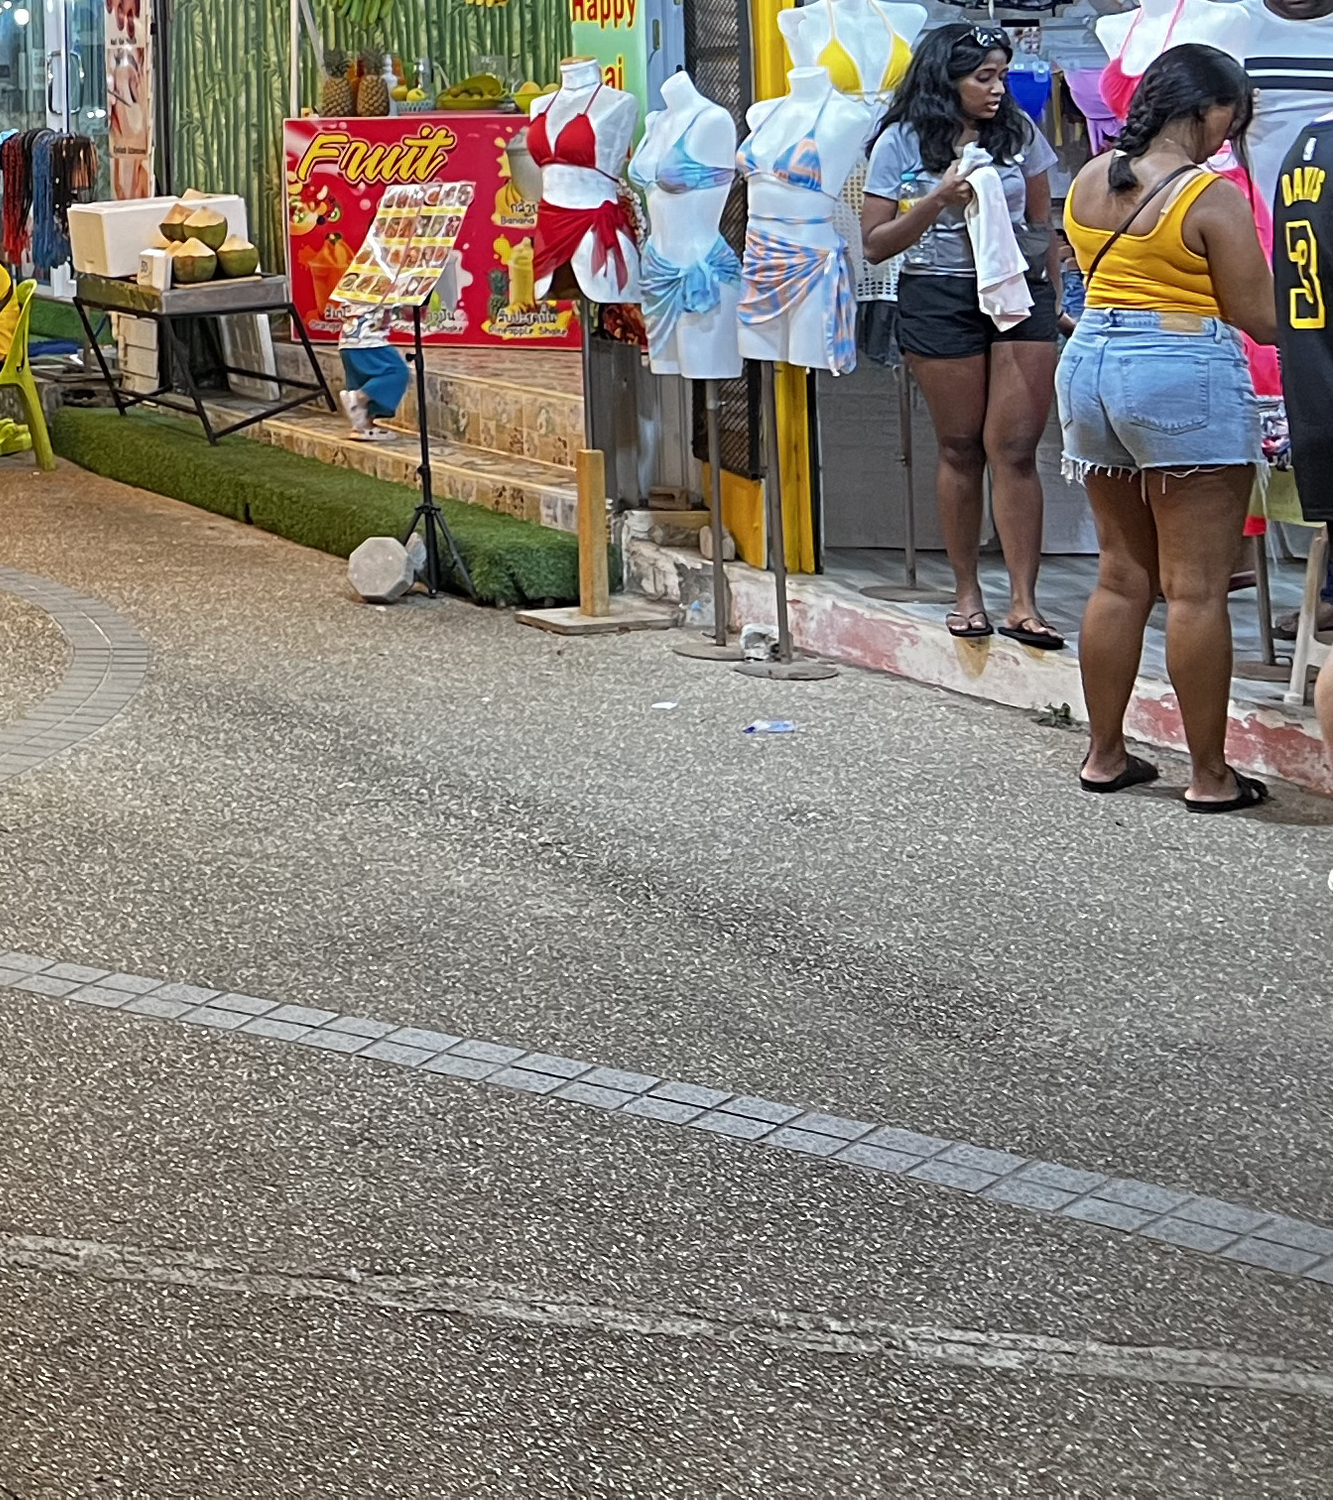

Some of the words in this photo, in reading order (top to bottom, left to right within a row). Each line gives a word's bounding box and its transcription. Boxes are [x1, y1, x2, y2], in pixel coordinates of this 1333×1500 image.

[296, 124, 456, 184] Fruit
[1281, 166, 1326, 207] DAVIS
[500, 215, 535, 225] Banana
[1285, 220, 1326, 330] 3
